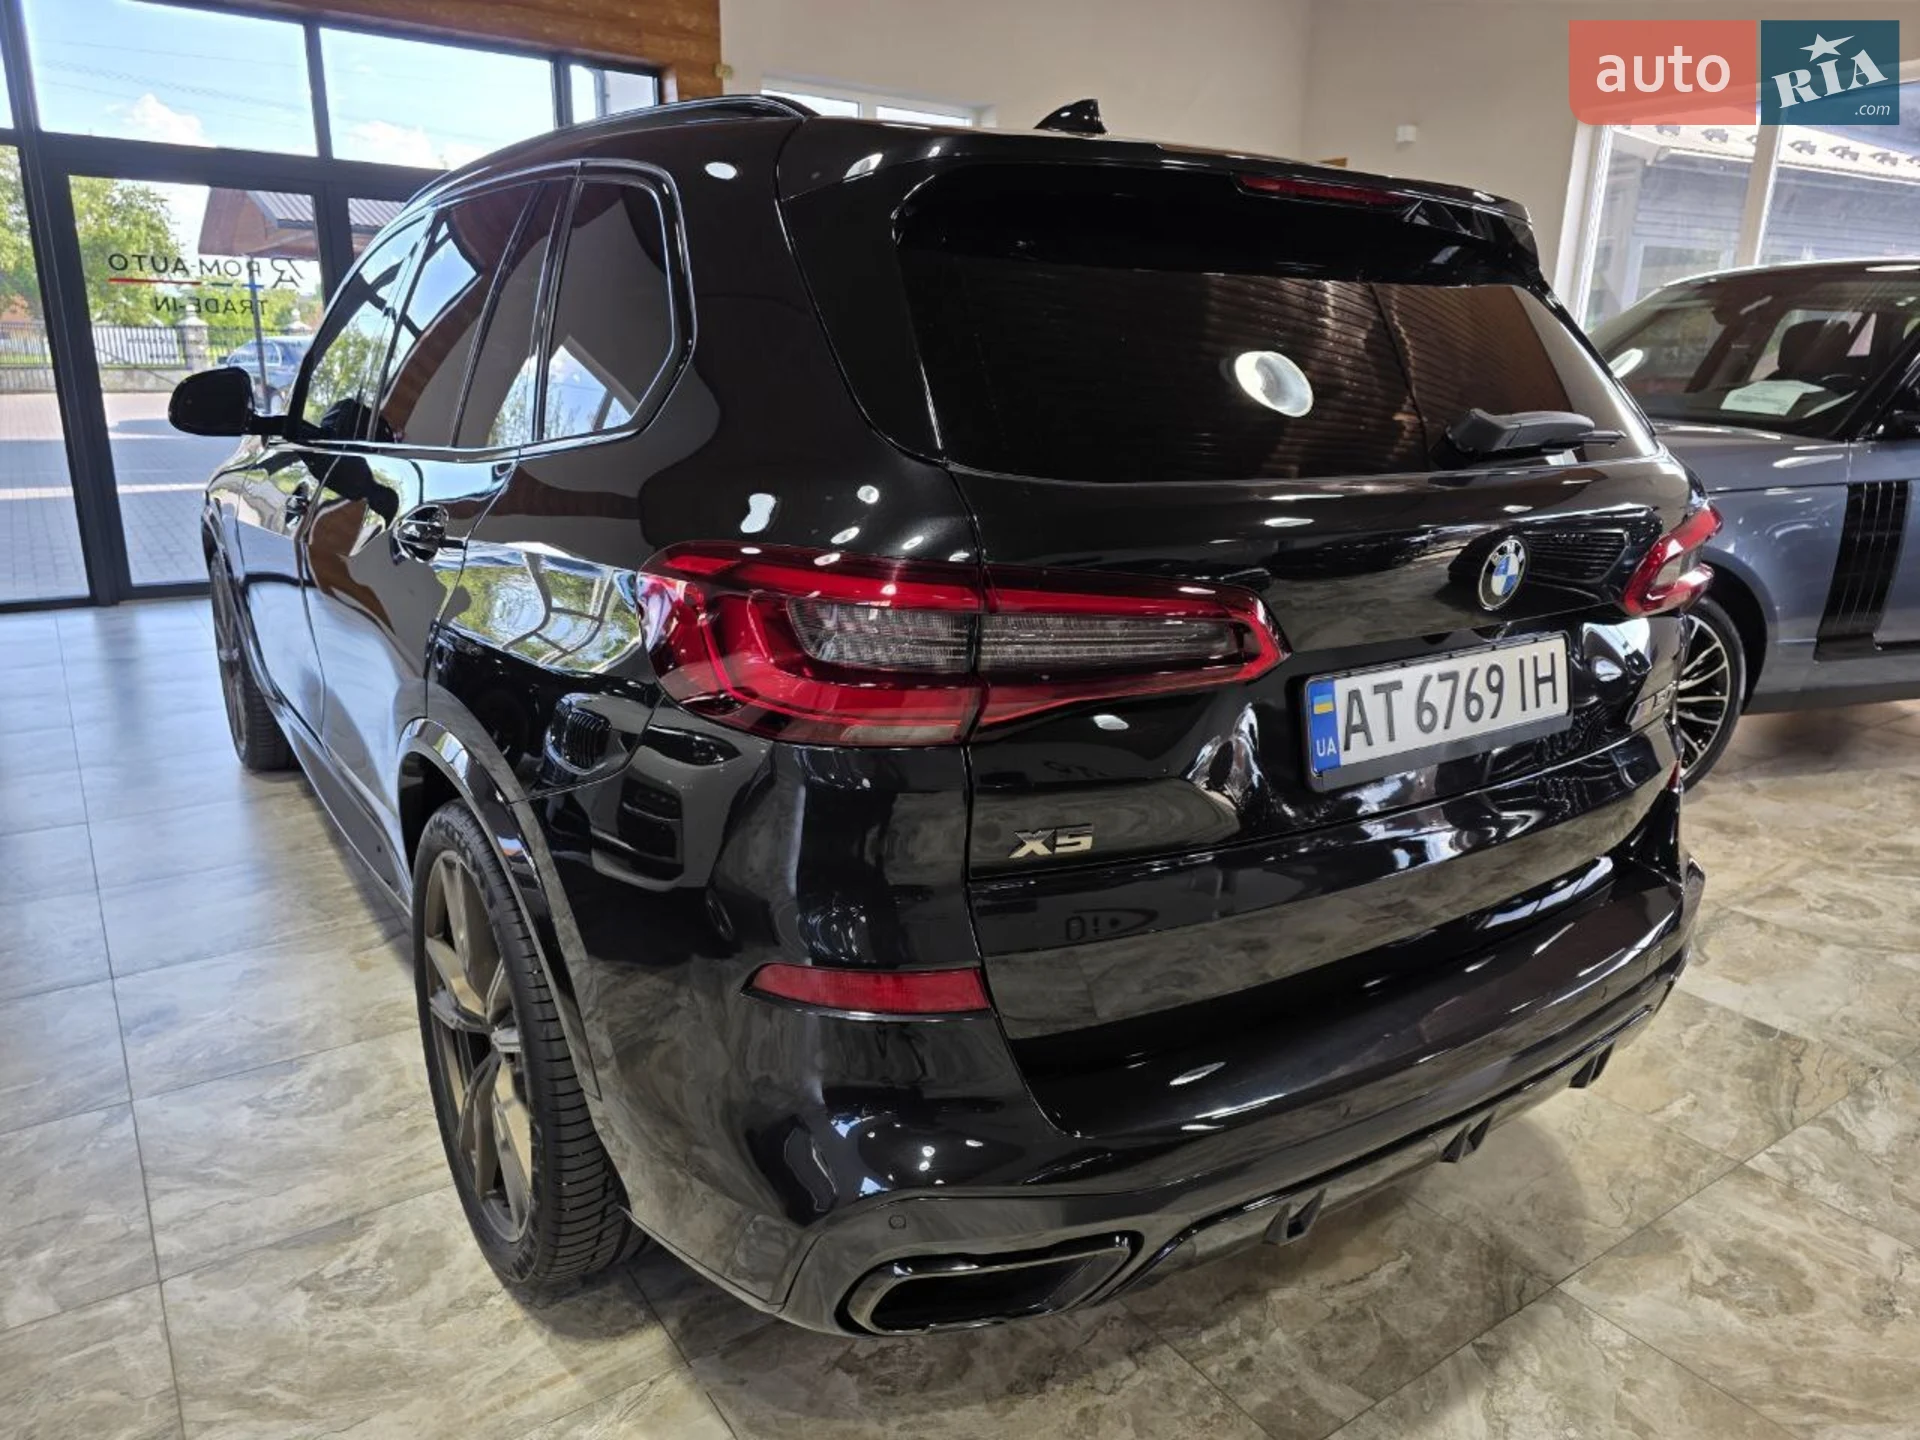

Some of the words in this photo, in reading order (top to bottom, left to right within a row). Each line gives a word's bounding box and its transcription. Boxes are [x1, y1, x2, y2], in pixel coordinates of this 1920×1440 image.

[1343, 681, 1404, 751] AT
[1415, 664, 1504, 734] 6769
[1518, 652, 1558, 712] IH
[1316, 736, 1338, 757] UA
[1009, 823, 1095, 859] X5
